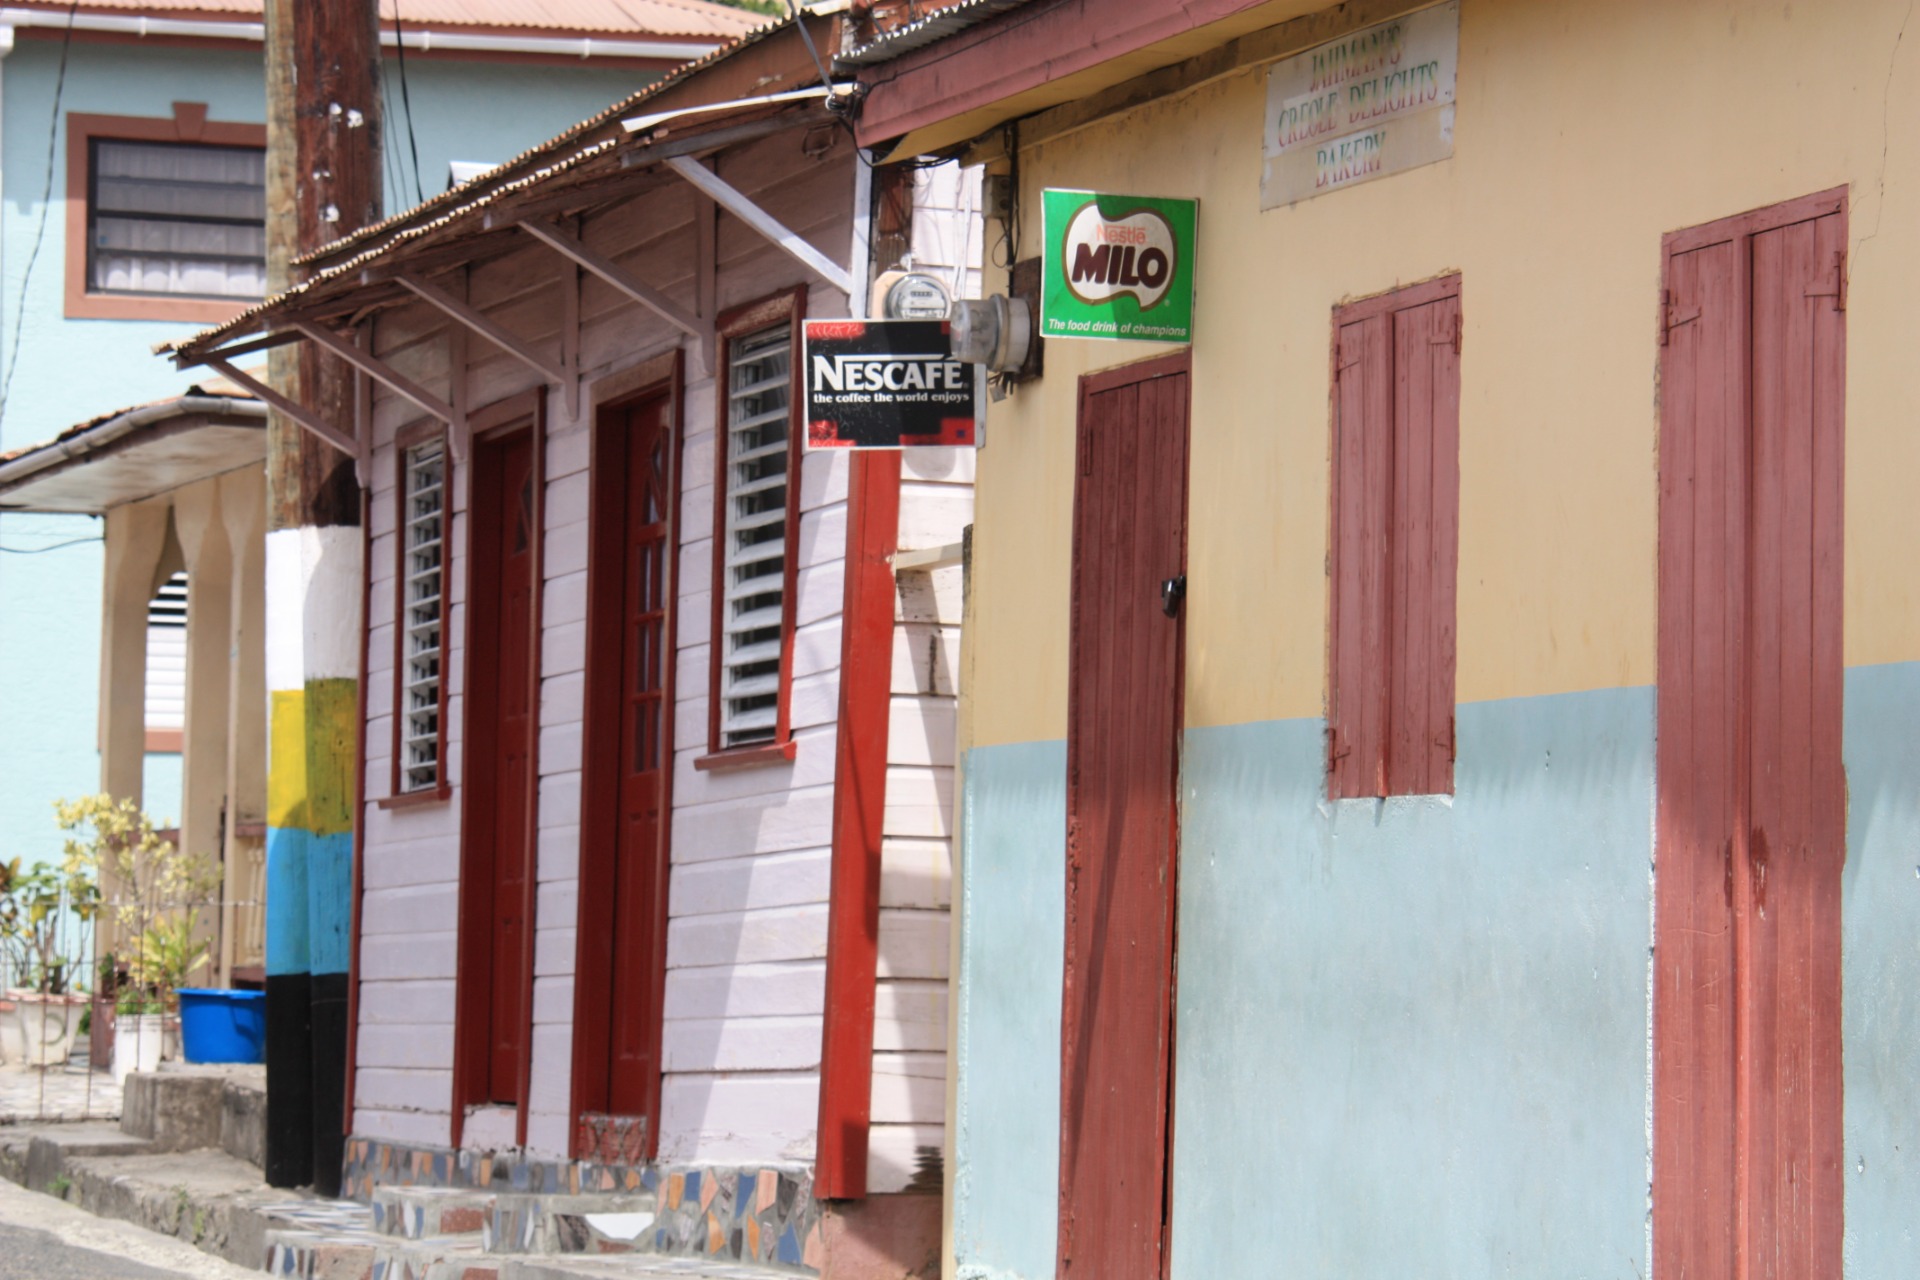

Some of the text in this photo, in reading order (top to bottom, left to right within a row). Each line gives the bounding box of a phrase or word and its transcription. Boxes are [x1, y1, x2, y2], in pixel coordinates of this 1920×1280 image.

[1279, 60, 1439, 147] CREOLE DELIGHTS
[1316, 131, 1387, 188] BAKERY
[1072, 243, 1168, 289] MILO
[1048, 319, 1187, 337] The food drink of champions
[813, 392, 970, 404] the coffee the world enjoys
